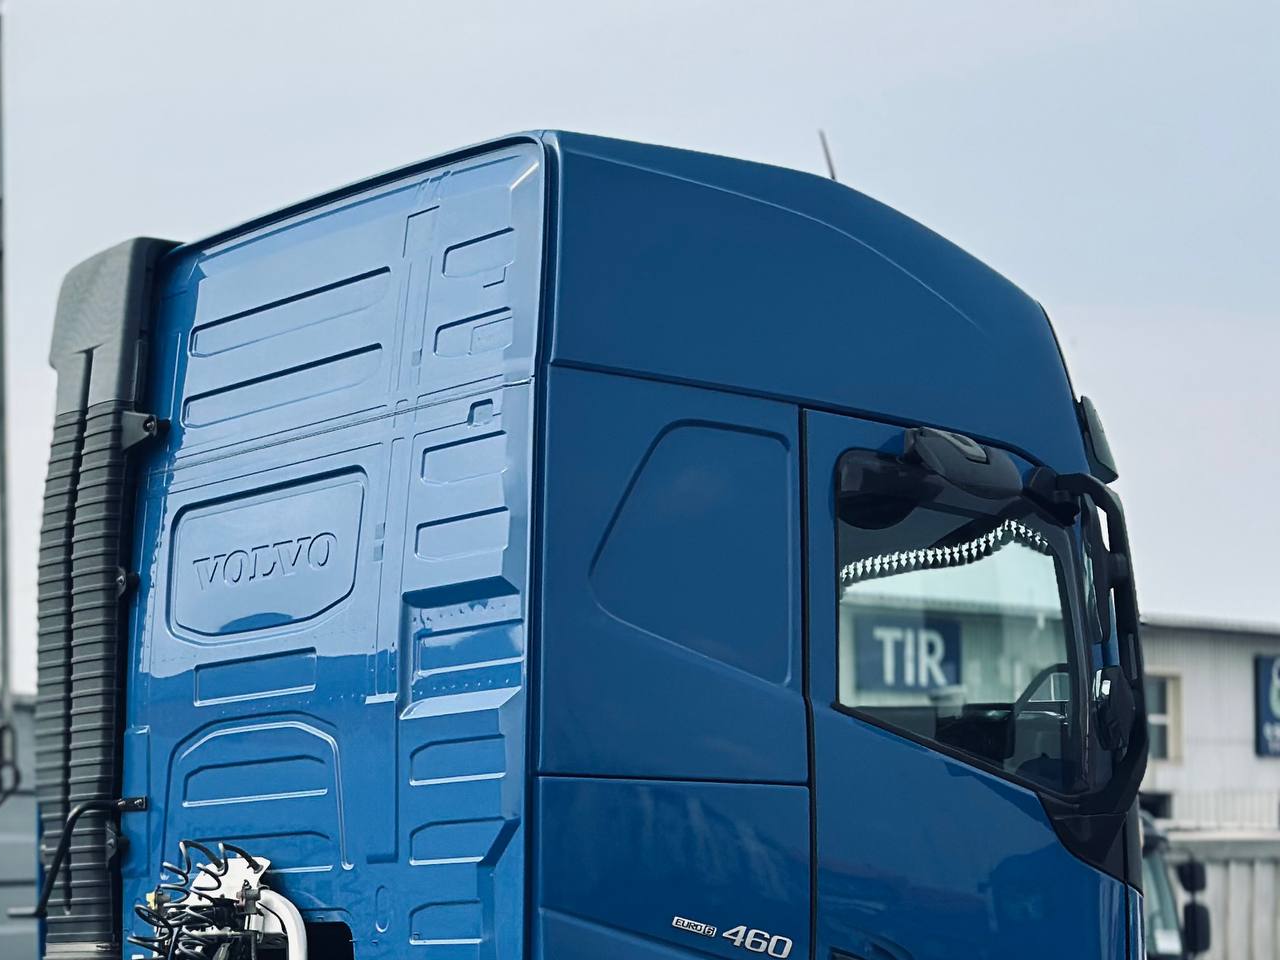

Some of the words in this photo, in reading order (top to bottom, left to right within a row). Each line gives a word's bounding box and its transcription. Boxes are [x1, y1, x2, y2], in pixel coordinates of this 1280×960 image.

[192, 531, 338, 591] VOLVO
[872, 626, 948, 688] TIR
[722, 925, 793, 959] 460
